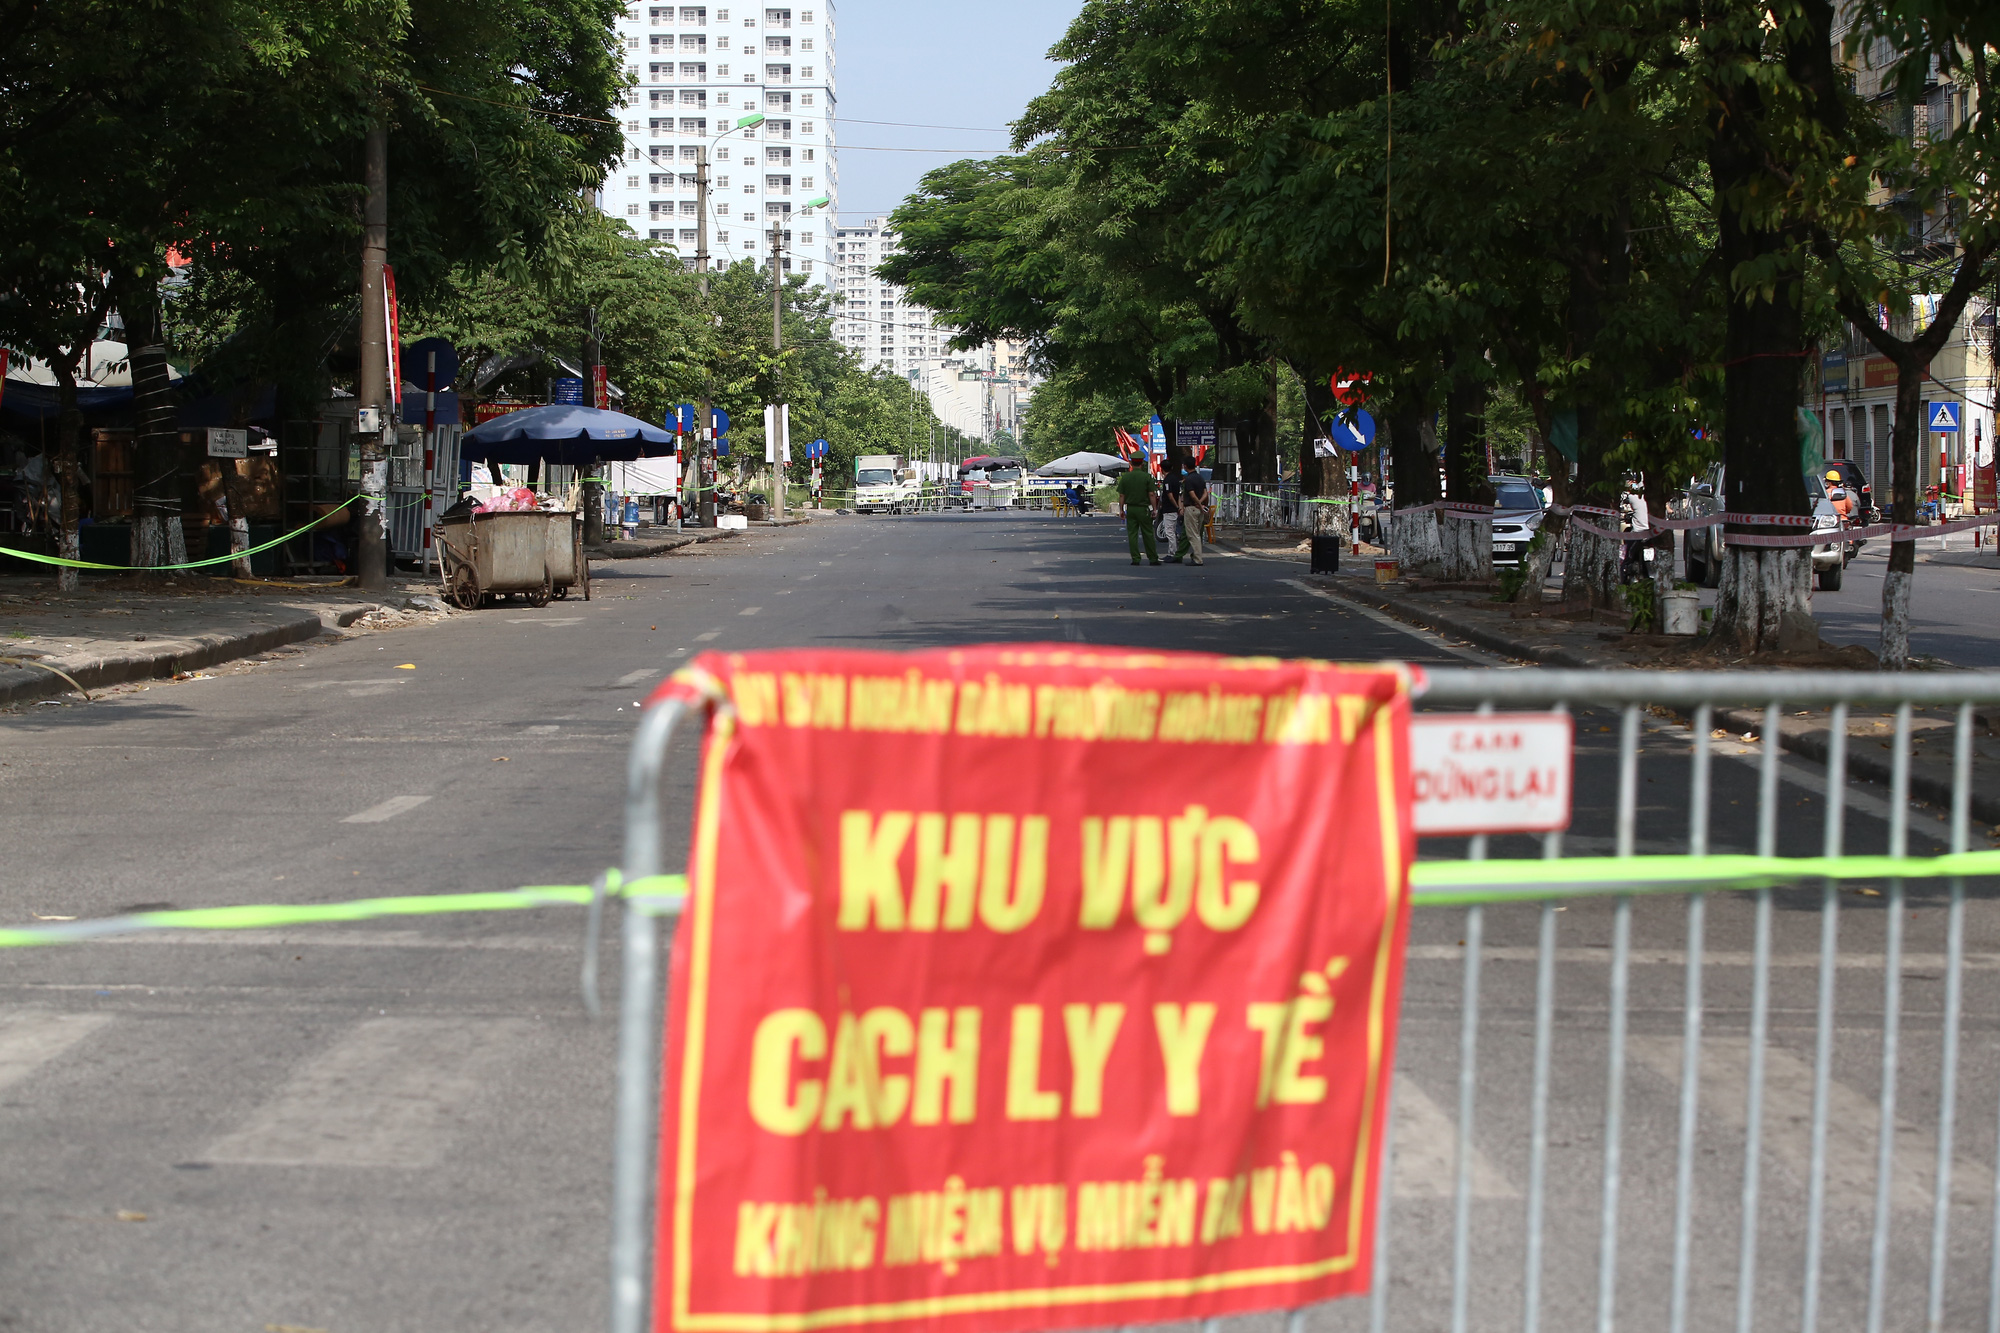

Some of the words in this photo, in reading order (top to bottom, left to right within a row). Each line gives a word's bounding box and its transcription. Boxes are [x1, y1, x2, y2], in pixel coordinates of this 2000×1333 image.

[837, 809, 1050, 934] KHU
[1079, 804, 1260, 956] VỰC
[748, 983, 982, 1137] CÁCH
[1004, 1003, 1126, 1121] LY
[1152, 1003, 1217, 1117] Y
[1245, 955, 1350, 1111] TẾ
[1011, 1184, 1066, 1269] VỤ
[1076, 1153, 1197, 1252] MIỄN
[1251, 1149, 1334, 1235] VÀO
